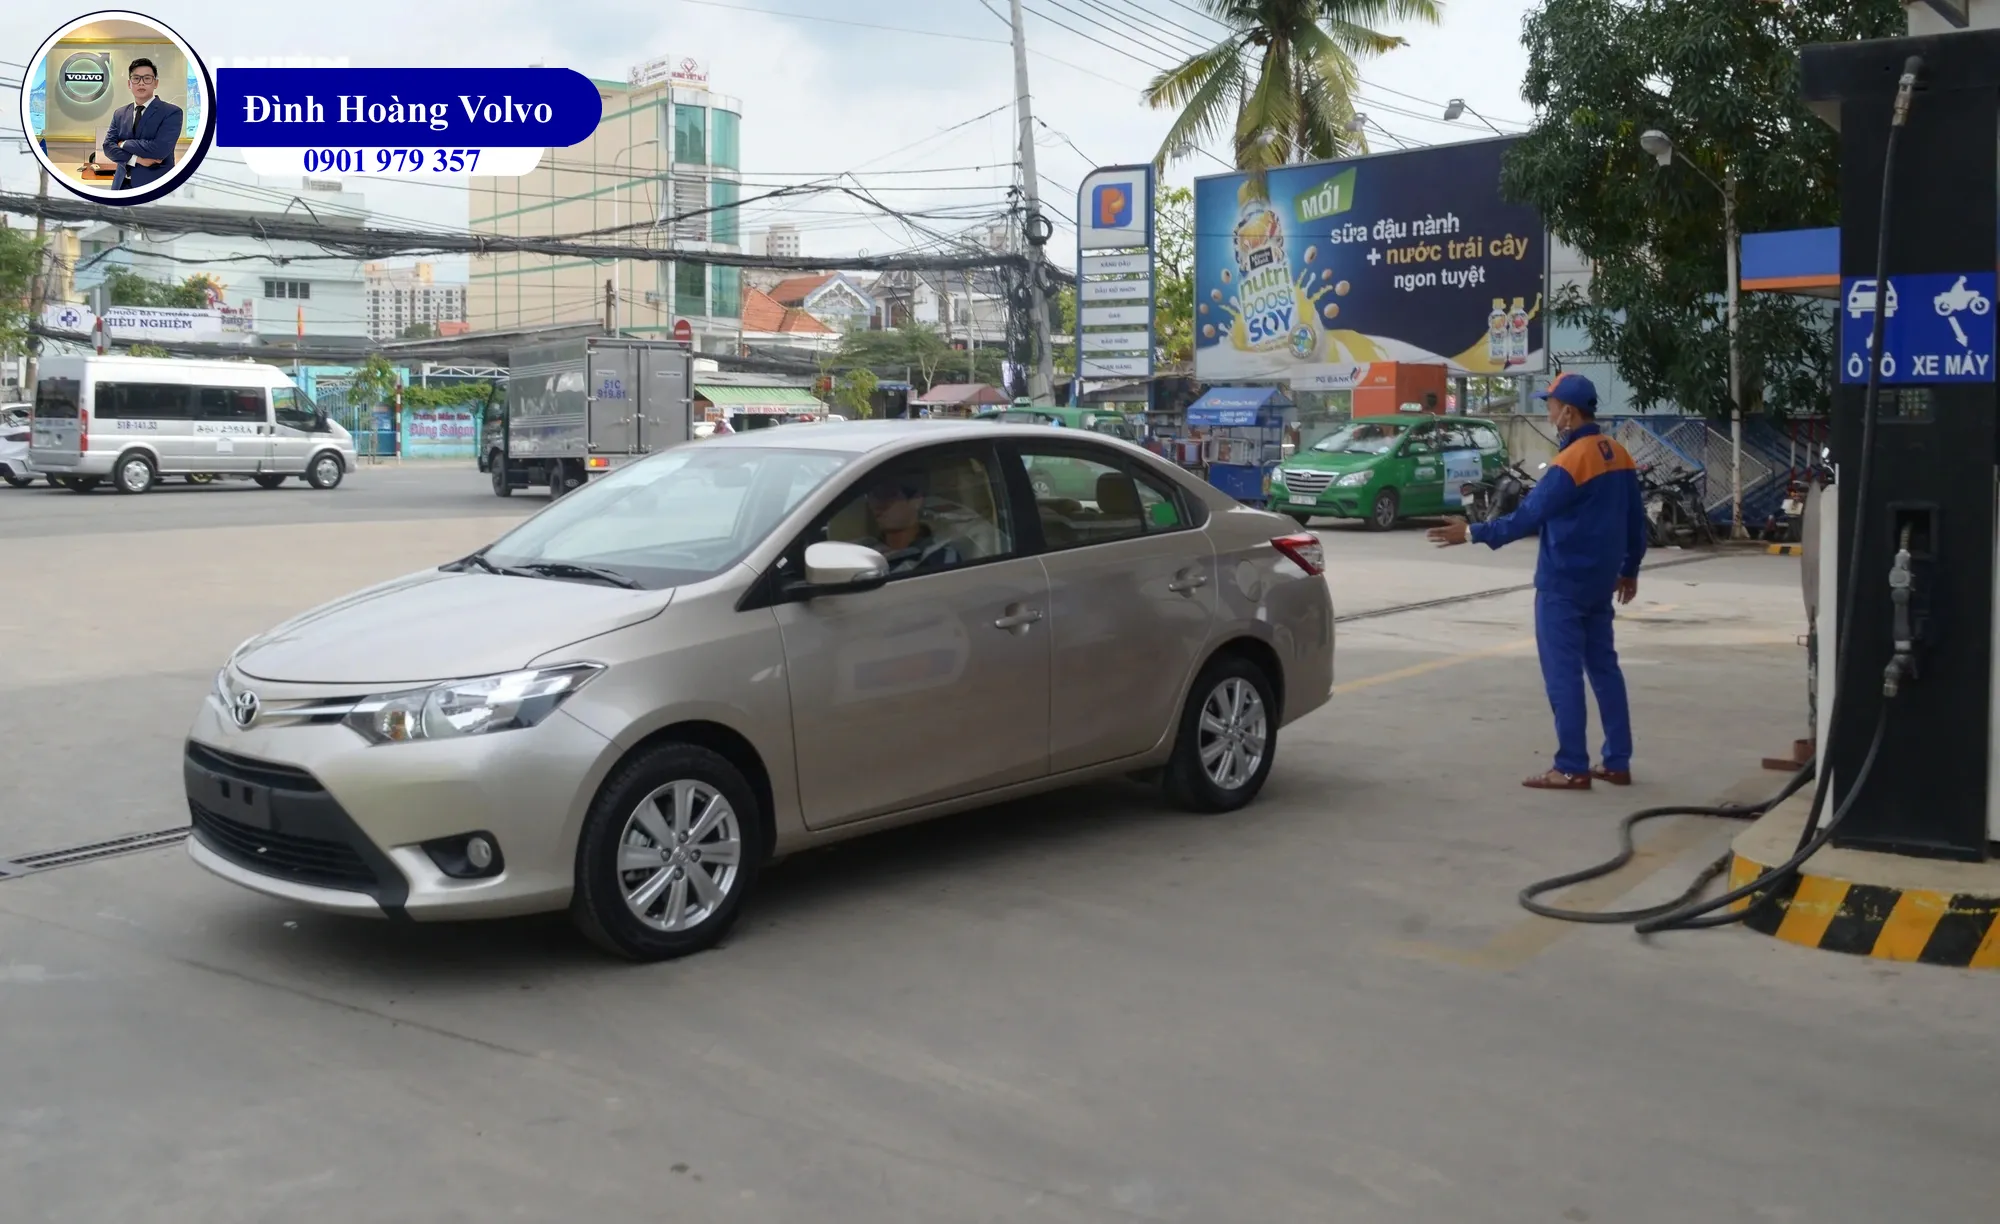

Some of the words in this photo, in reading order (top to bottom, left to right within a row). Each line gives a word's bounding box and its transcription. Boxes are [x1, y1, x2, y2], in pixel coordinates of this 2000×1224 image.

[1302, 182, 1340, 218] MỚI
[1330, 223, 1368, 245] sữa
[1372, 218, 1407, 244] đậu
[1412, 213, 1460, 237] nành
[1366, 248, 1381, 266] +
[1386, 240, 1442, 265] nước
[1448, 235, 1483, 260] trái
[1489, 232, 1529, 261] cây
[1240, 267, 1291, 300] nutri
[1394, 272, 1437, 292] ngon
[1441, 265, 1486, 287] tuyệt
[1243, 286, 1295, 322] boost
[105, 317, 136, 328] HIỆU
[140, 318, 193, 330] NGHIỆM
[1249, 307, 1293, 343] SOY
[1847, 352, 1863, 378] Ô
[1912, 355, 1940, 376] XE
[1945, 350, 1989, 375] MÁY
[604, 379, 621, 390] 51C
[1453, 469, 1479, 480] DAIKIN
